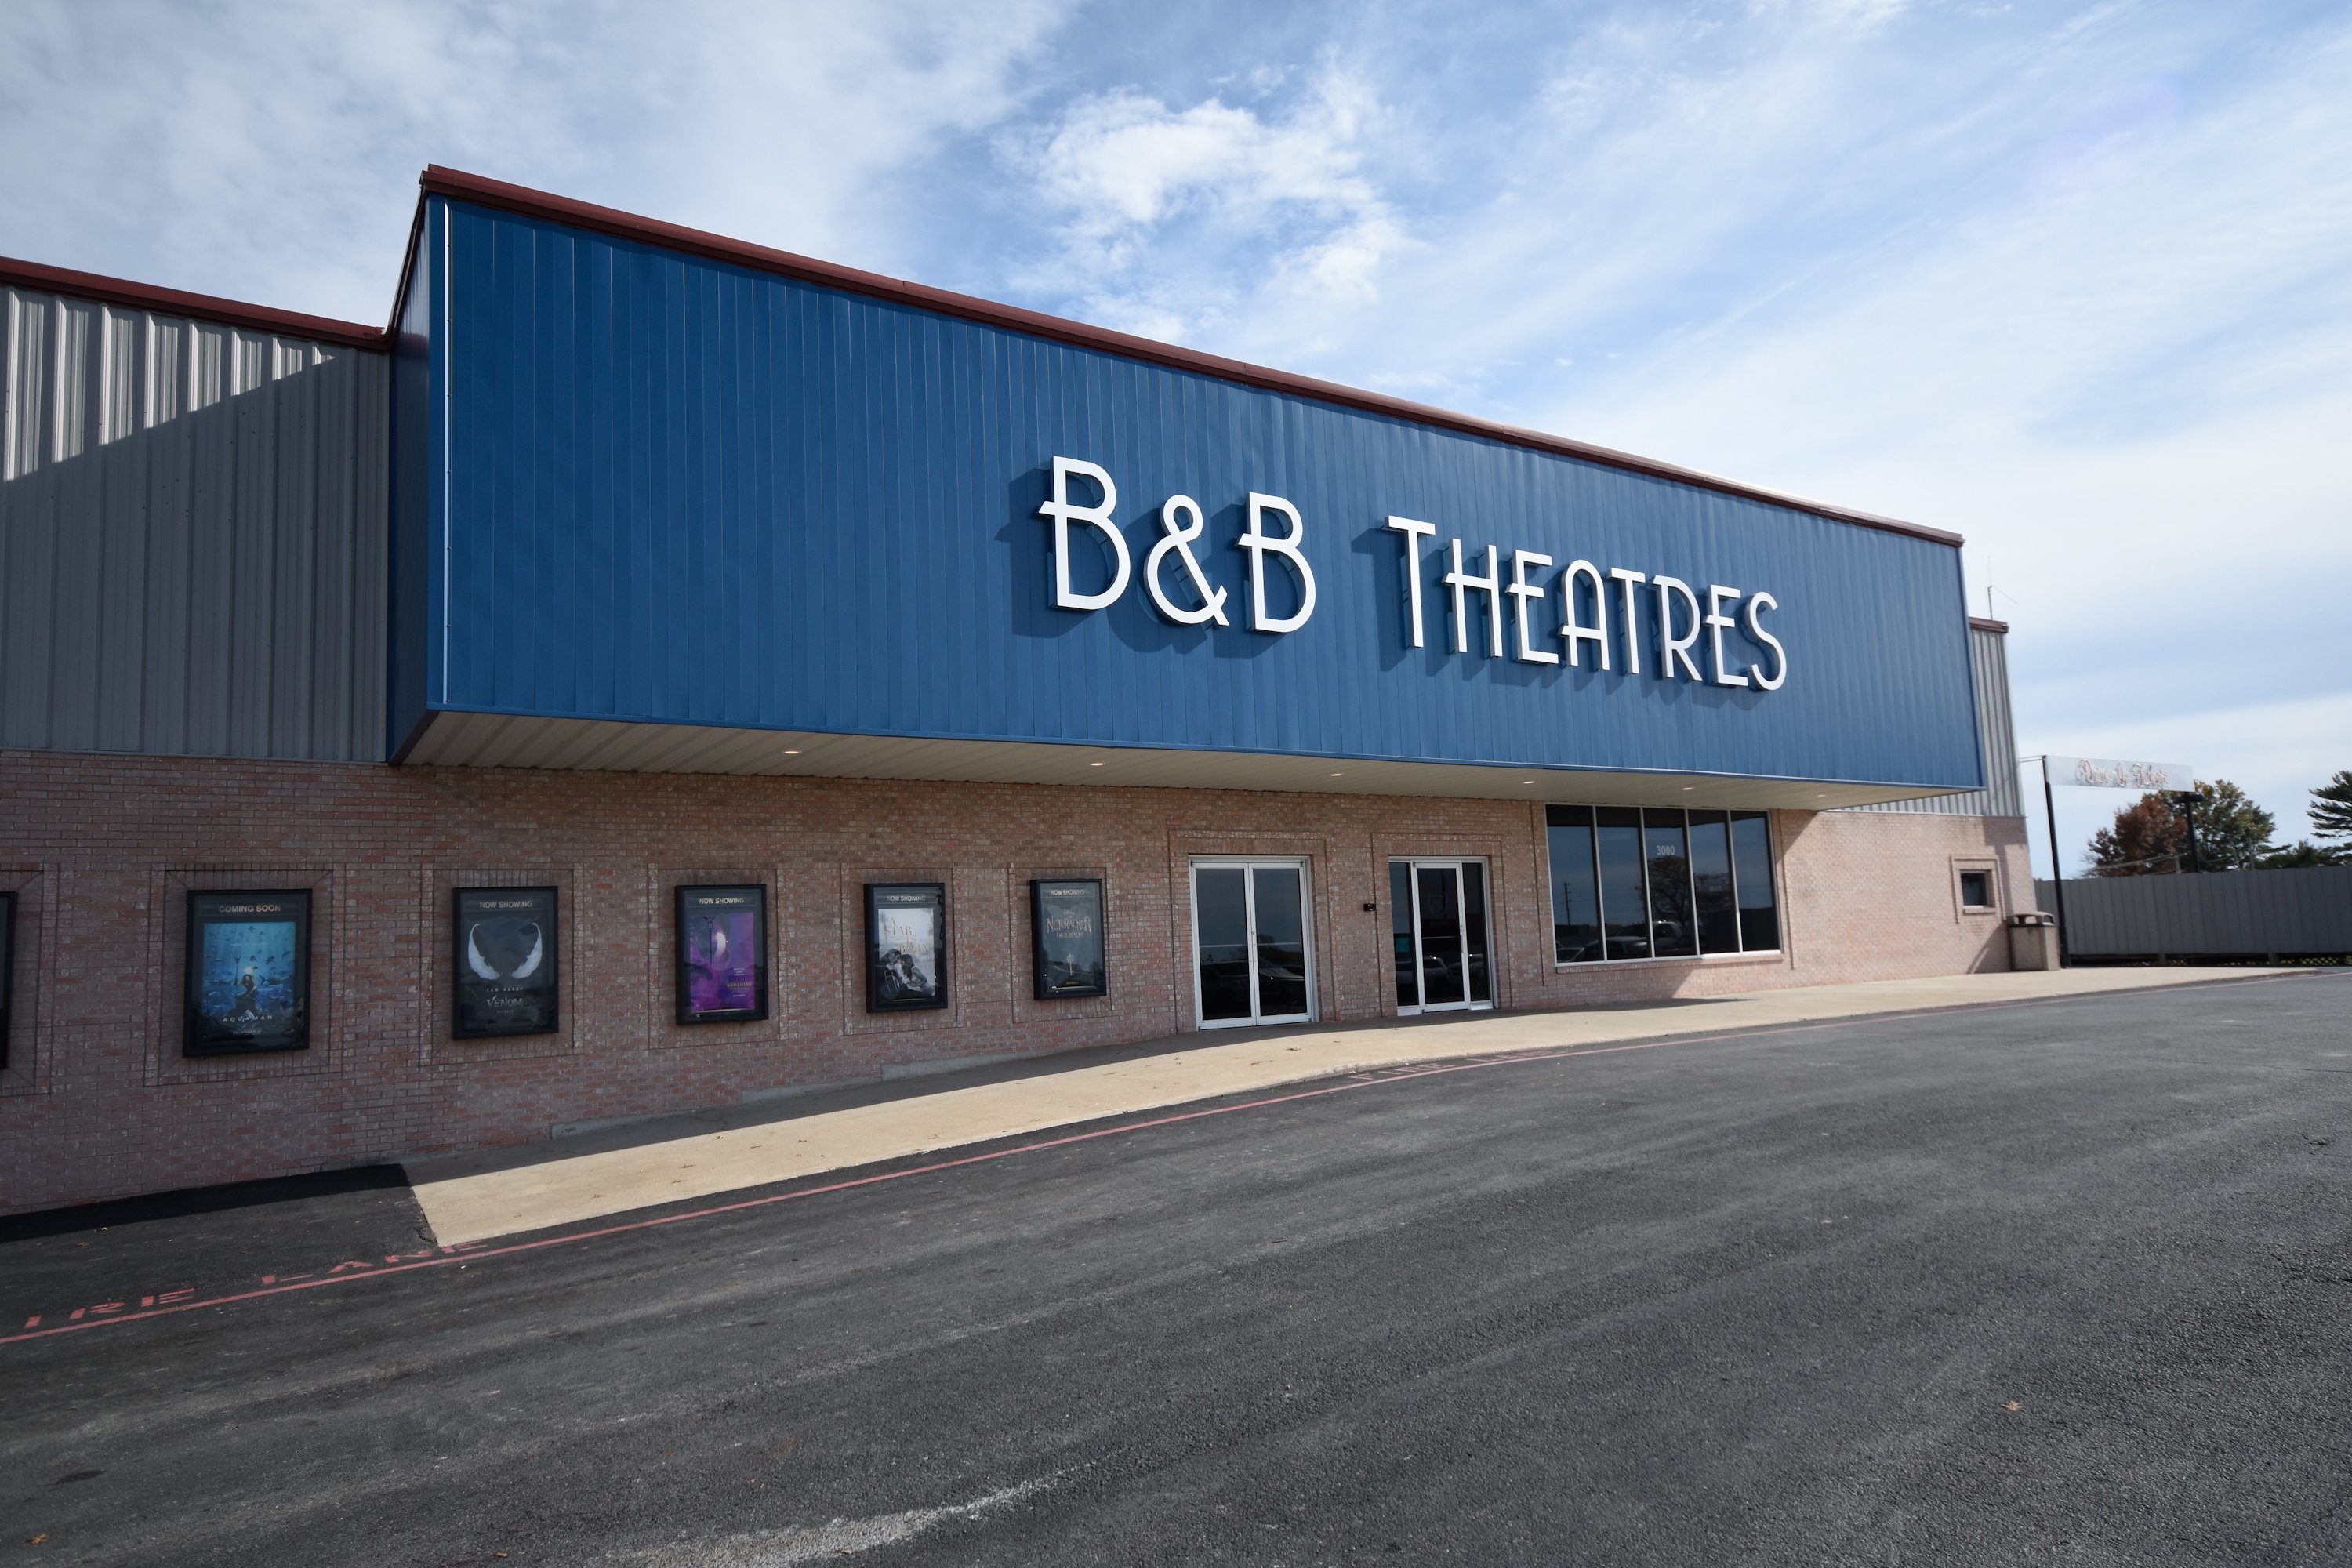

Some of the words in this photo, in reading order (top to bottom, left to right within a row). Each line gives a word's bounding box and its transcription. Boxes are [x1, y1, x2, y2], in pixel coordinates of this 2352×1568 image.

[1039, 455, 1316, 634] B&B
[1384, 515, 1787, 692] THEATRES
[1657, 845, 1675, 856] 3000
[219, 904, 254, 913] COMING
[256, 904, 281, 913] SOON
[884, 925, 913, 935] STAR
[898, 942, 928, 954] BORN
[486, 994, 523, 1009] VENOM
